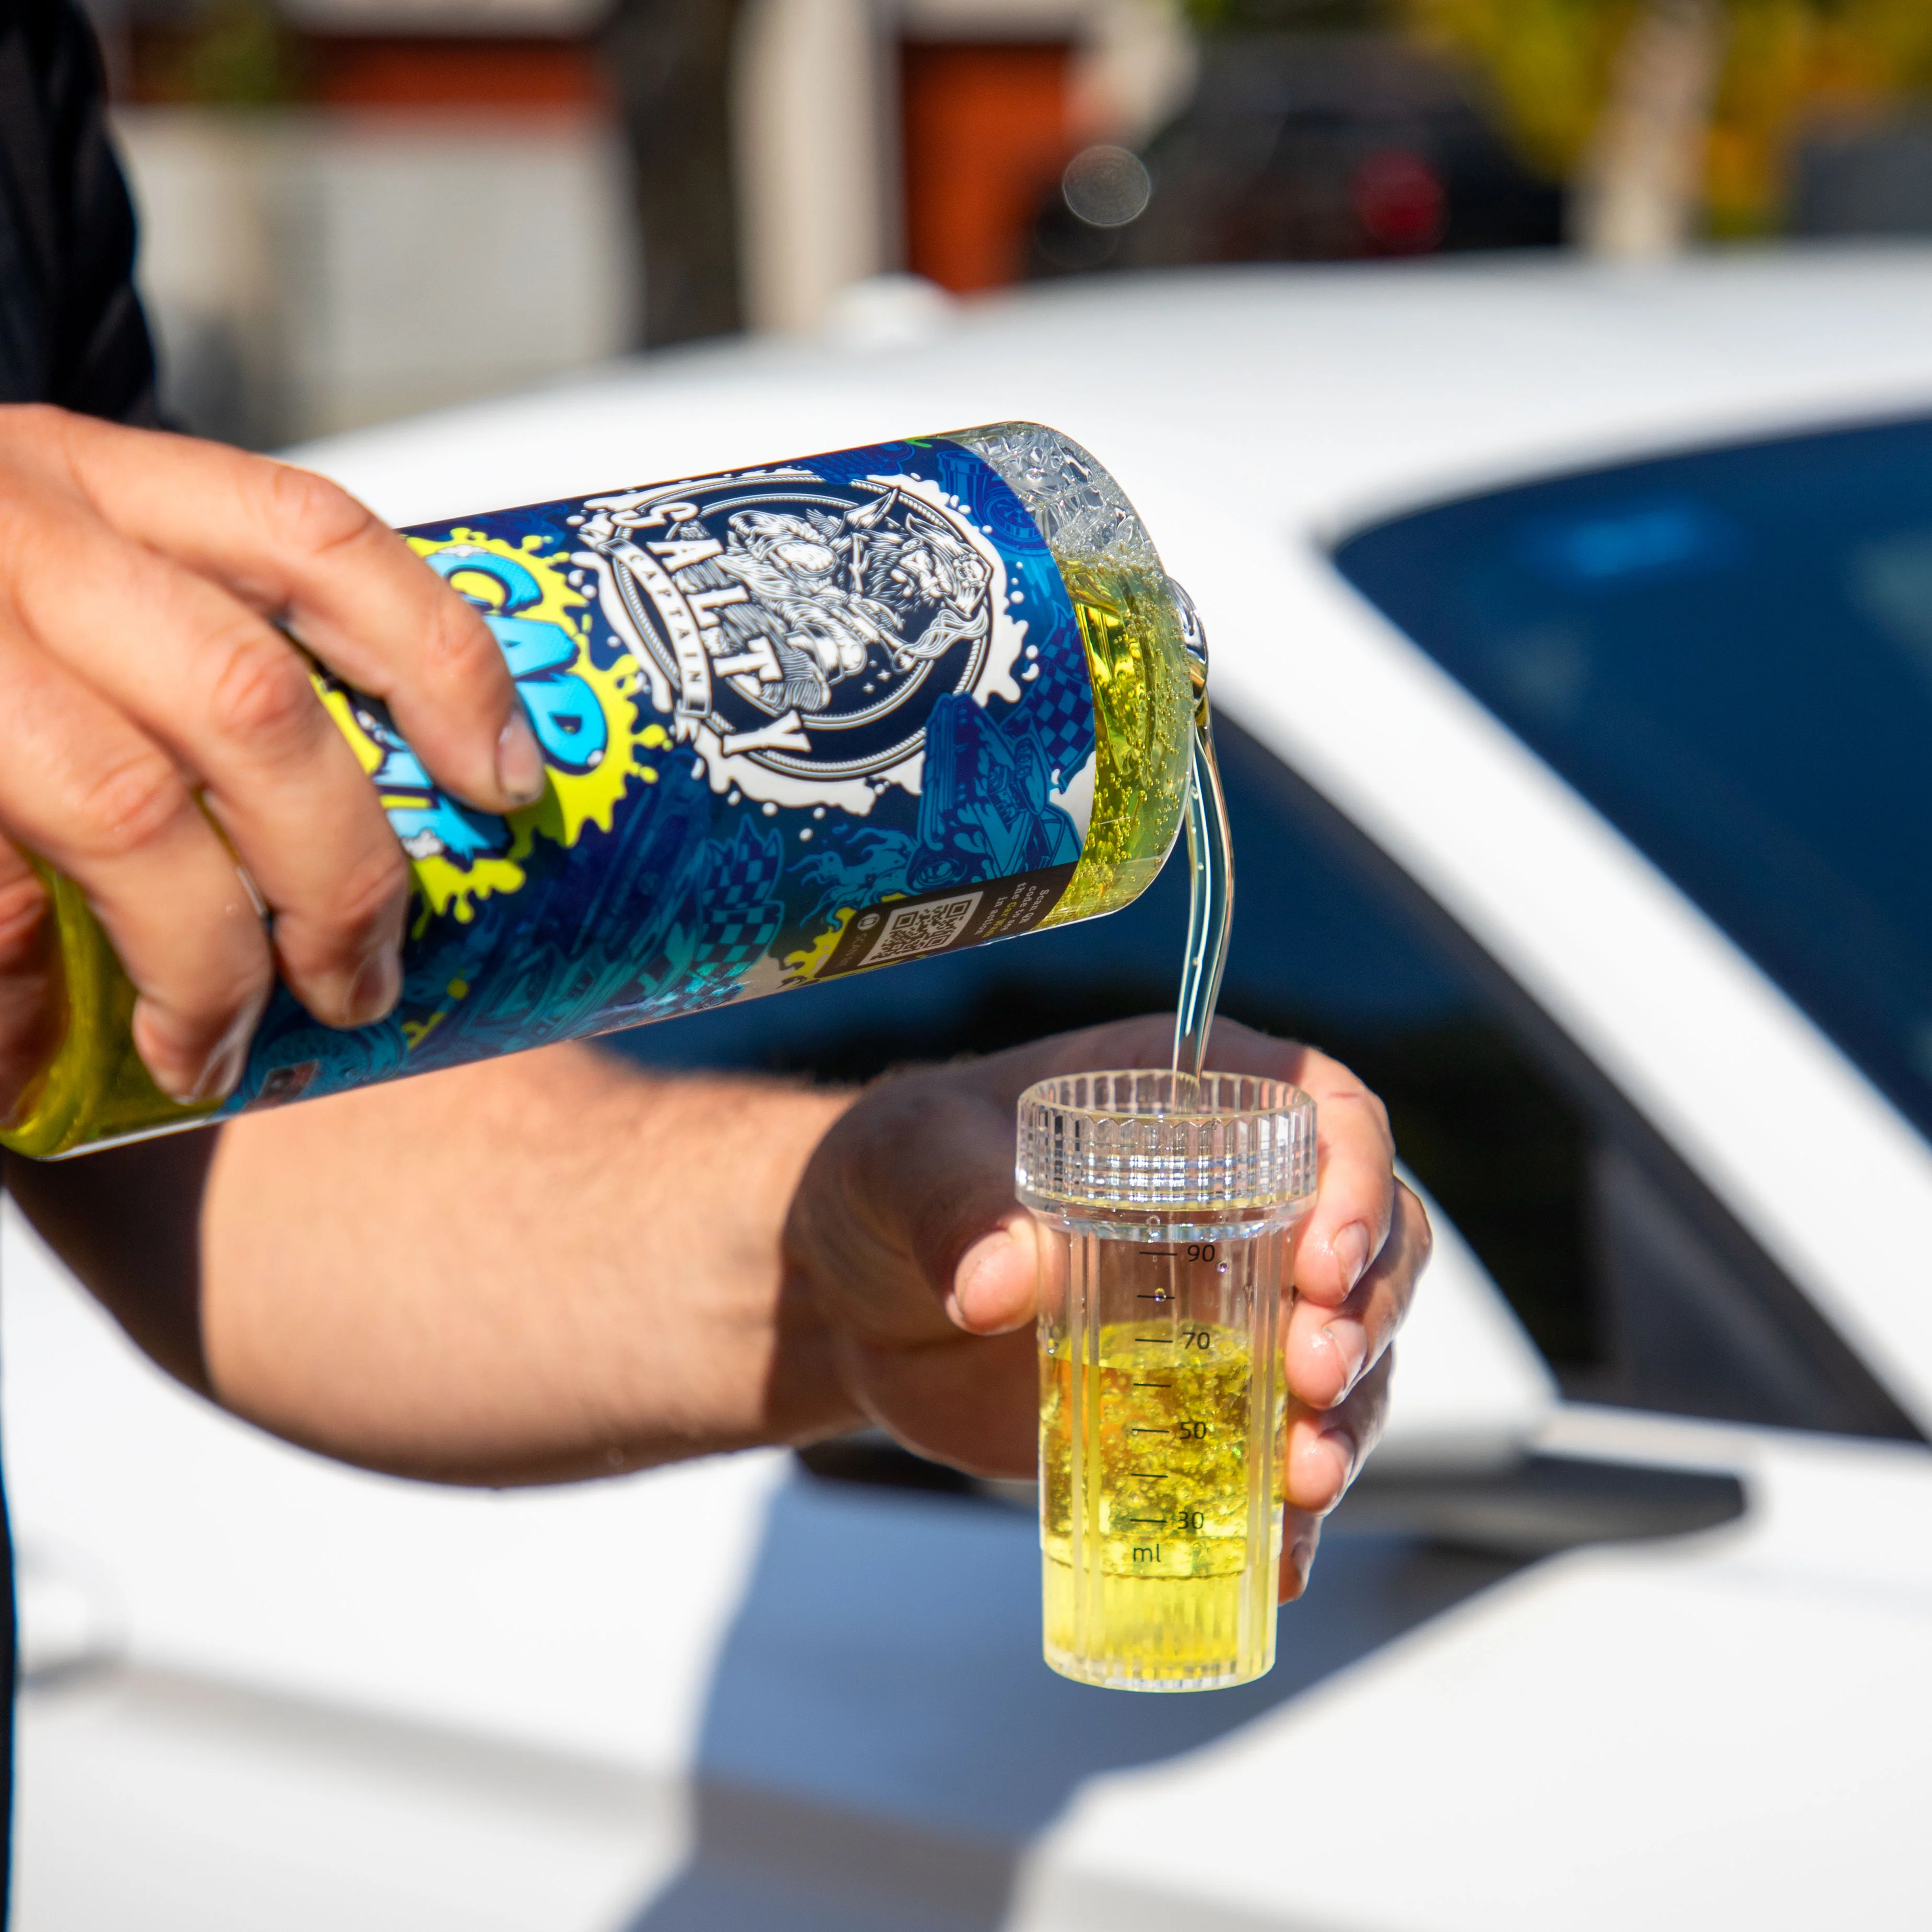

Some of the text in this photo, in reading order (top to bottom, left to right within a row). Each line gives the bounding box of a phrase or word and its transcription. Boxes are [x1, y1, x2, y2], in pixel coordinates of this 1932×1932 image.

[628, 552, 703, 684] CAPTAIN
[610, 502, 811, 755] SALTY
[1011, 882, 1028, 900] the
[1020, 886, 1037, 908] code
[974, 896, 1009, 935] in action
[1001, 902, 1017, 917] Car
[1012, 909, 1025, 918] to
[1018, 889, 1050, 924] Scan QR
[1187, 1244, 1215, 1263] 90
[1182, 1332, 1210, 1350] 70
[1179, 1421, 1207, 1440] 50
[1177, 1511, 1205, 1530] 30
[1133, 1543, 1162, 1563] ml
